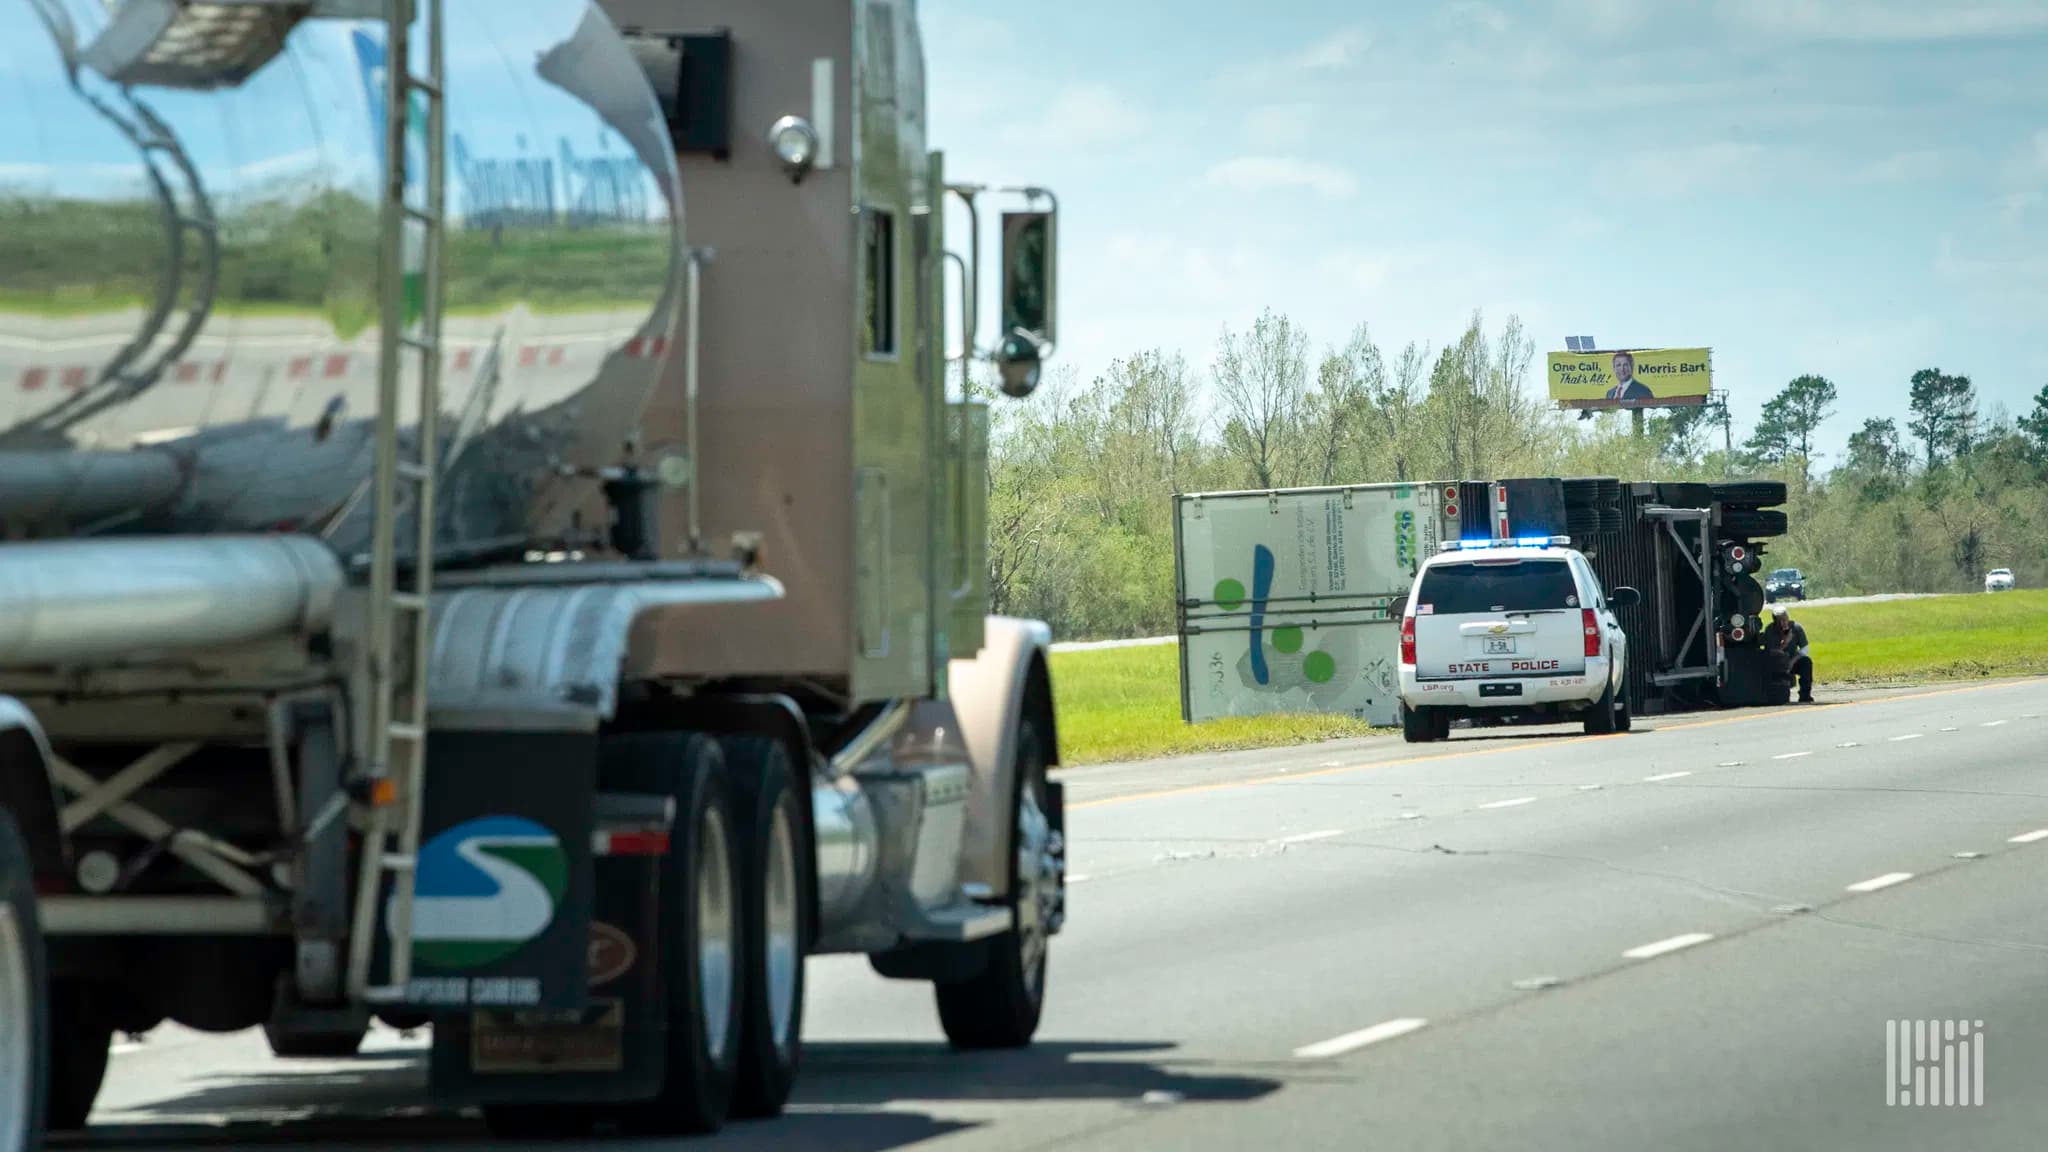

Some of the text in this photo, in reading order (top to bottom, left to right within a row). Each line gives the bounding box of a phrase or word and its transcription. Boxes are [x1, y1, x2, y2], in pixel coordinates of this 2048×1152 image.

[1552, 361, 1602, 372] One Call,
[1638, 362, 1706, 375] Morris Bart
[1560, 373, 1588, 384] That's
[1448, 660, 1560, 673] STATE POLICE
